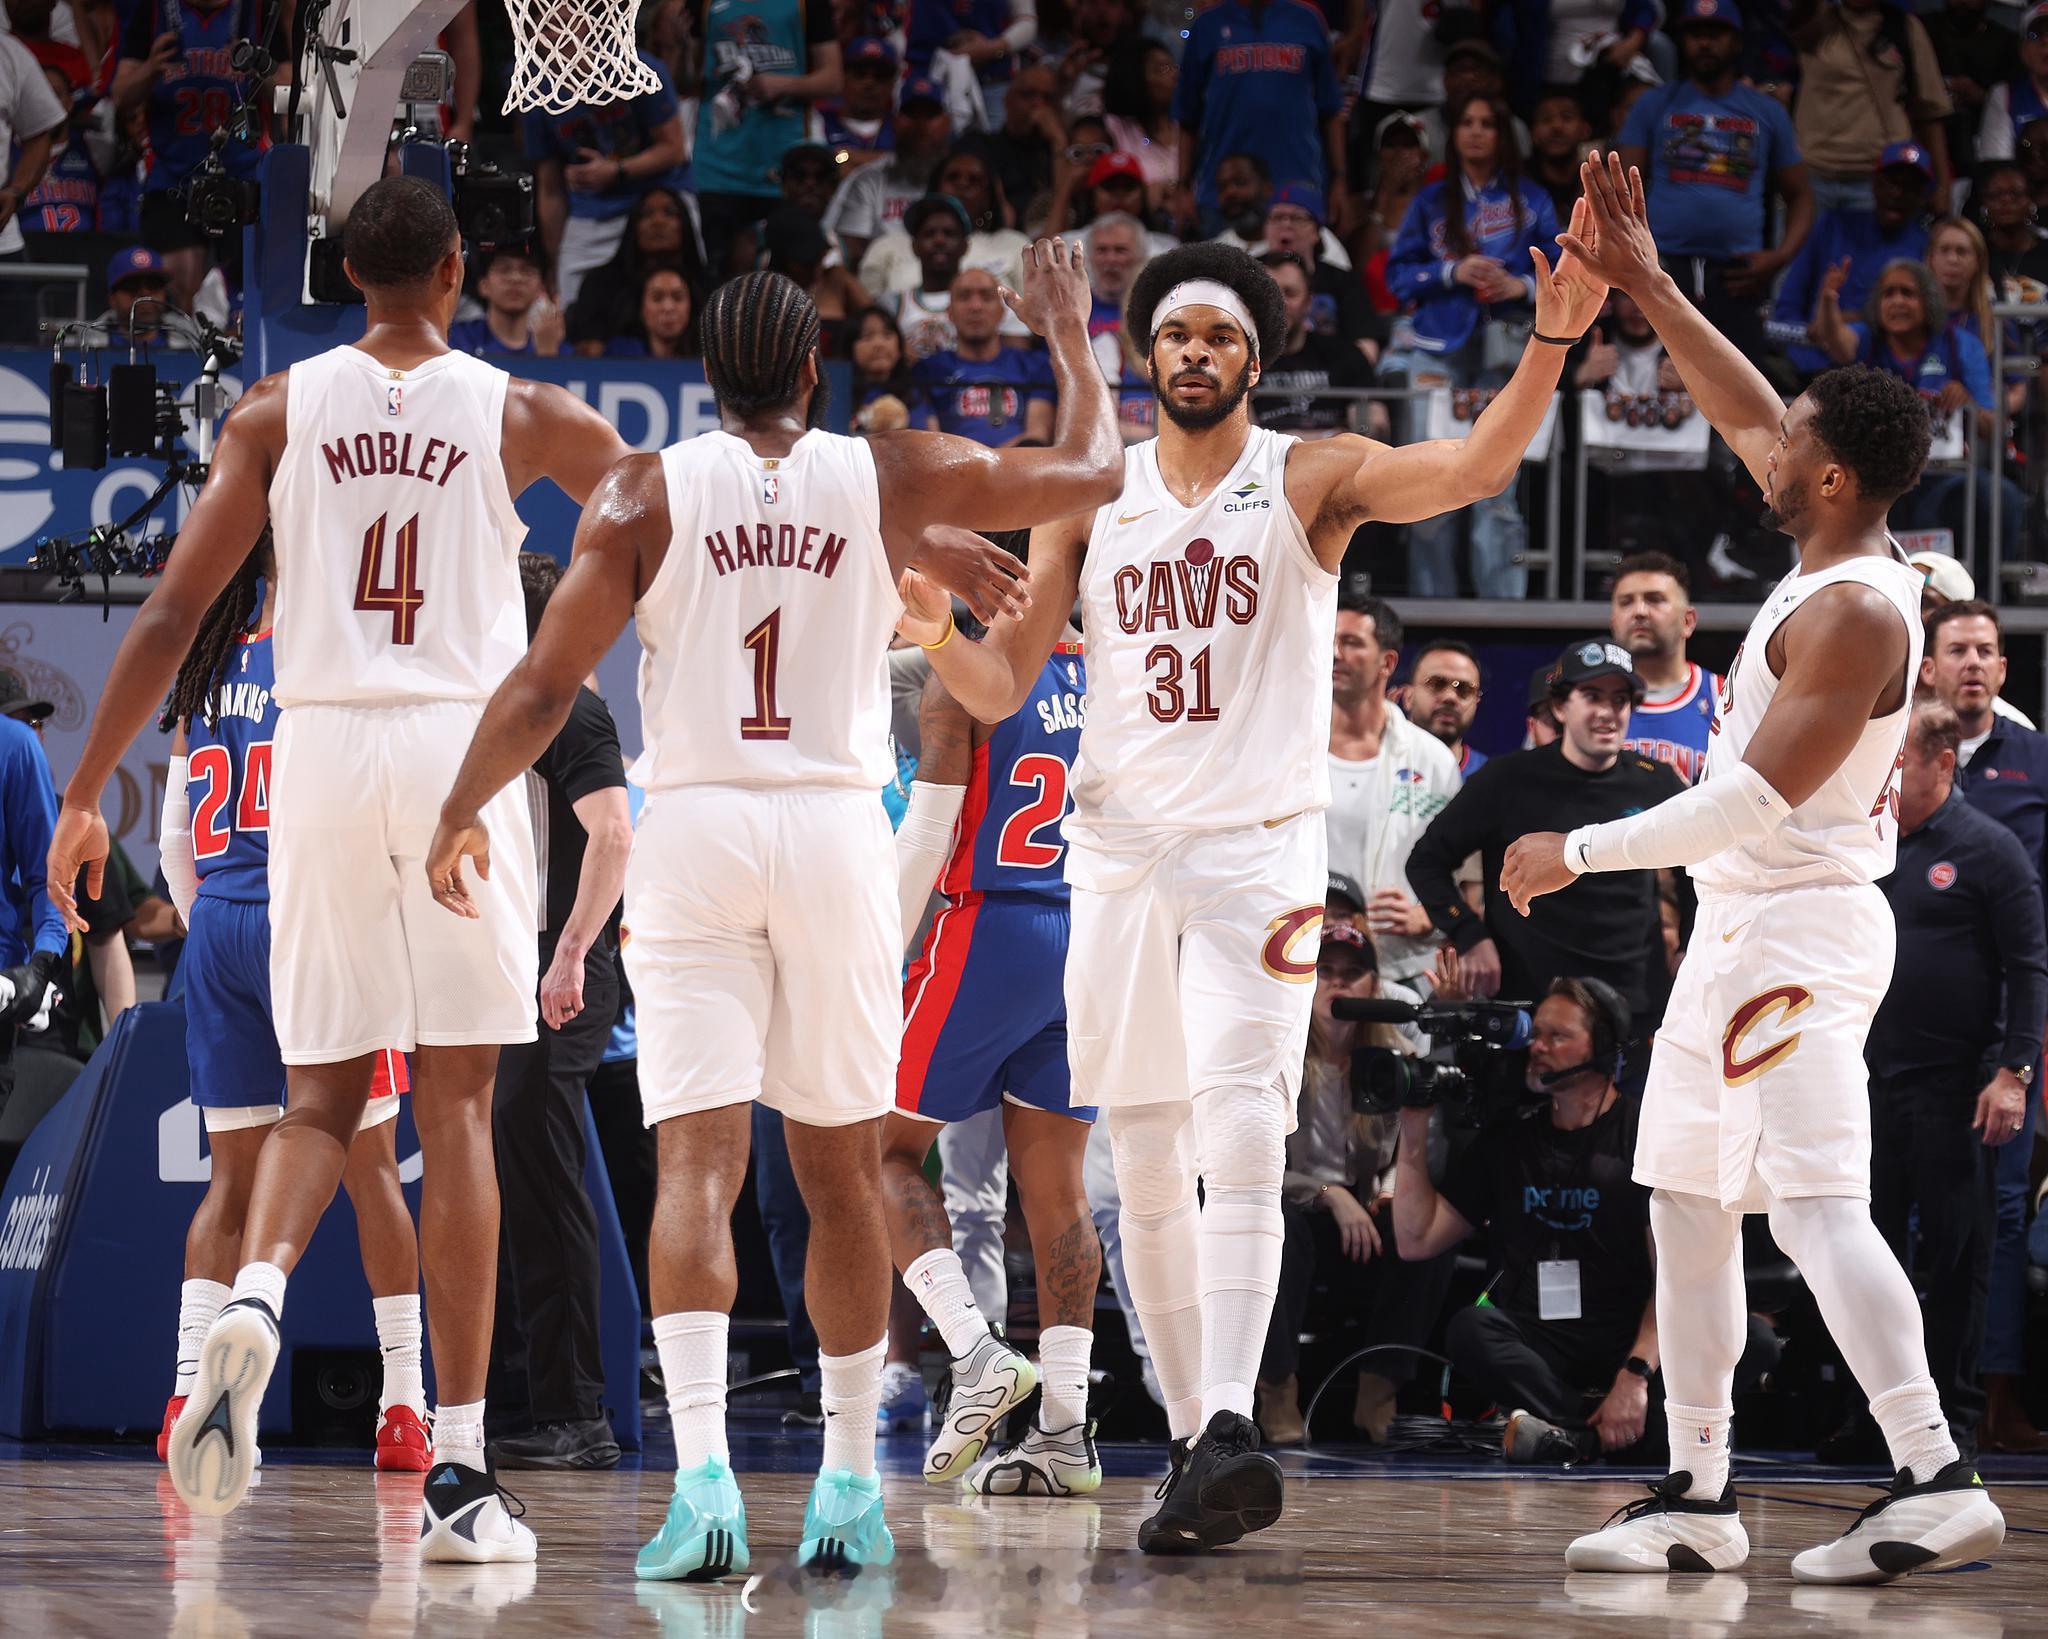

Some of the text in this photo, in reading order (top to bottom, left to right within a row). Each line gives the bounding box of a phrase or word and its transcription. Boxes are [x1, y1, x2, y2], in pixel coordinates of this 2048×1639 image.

[1216, 43, 1306, 76] PISTONS
[321, 431, 468, 487] MOBLEY
[1223, 500, 1270, 513] CLIFFS
[353, 511, 424, 645] 4
[705, 524, 847, 579] HARDEN
[1113, 555, 1260, 635] CAVS
[741, 606, 792, 740] 1
[1145, 644, 1221, 723] 31
[186, 740, 271, 861] 24
[997, 753, 1069, 869] 2
[1521, 1183, 1601, 1215] prme
